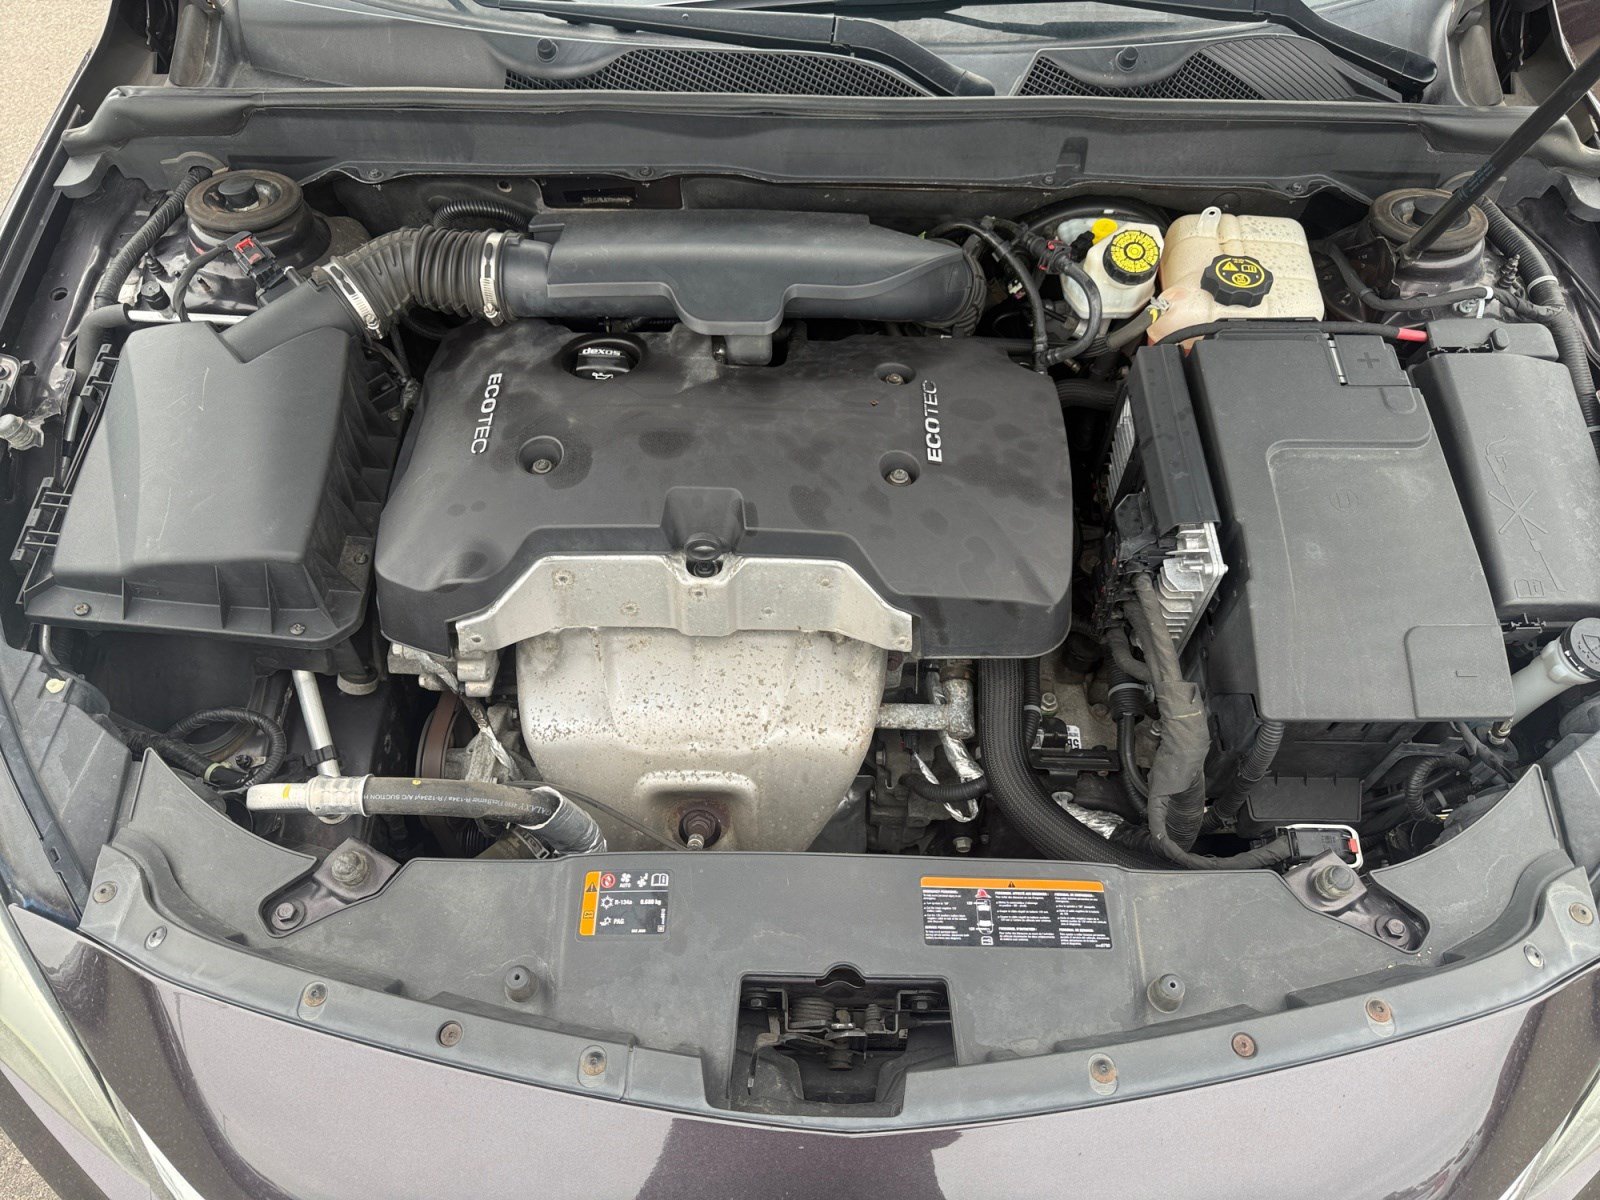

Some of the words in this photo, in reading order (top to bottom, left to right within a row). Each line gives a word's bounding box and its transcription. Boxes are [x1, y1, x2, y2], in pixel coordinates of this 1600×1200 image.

[582, 347, 620, 357] dexos
[470, 372, 503, 455] ECOTEC
[922, 380, 943, 462] ECOTEC
[517, 802, 553, 816] GALAXY
